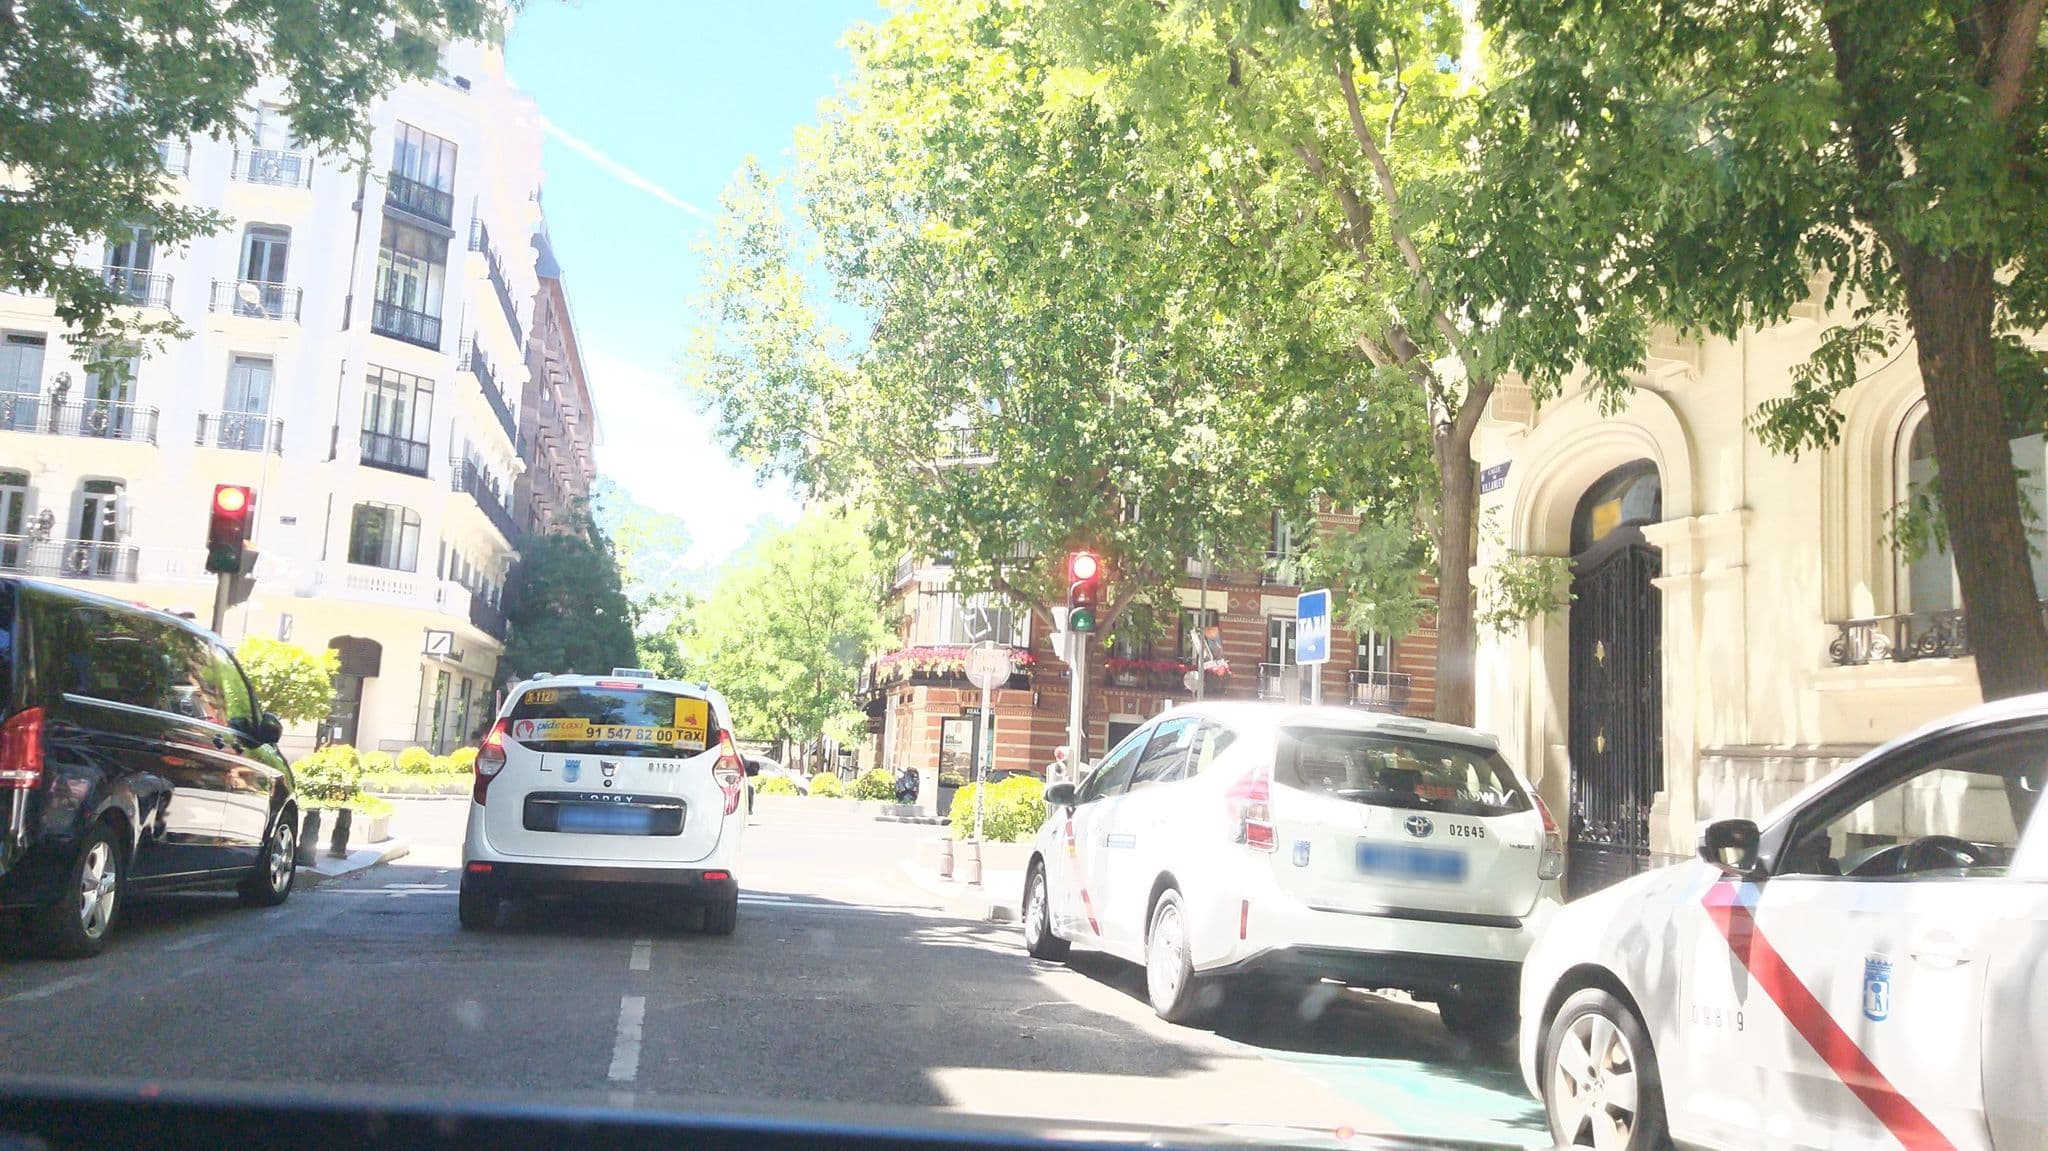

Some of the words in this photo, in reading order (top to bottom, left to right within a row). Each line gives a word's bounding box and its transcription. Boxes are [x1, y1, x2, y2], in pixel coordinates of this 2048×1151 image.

[1298, 614, 1327, 635] TAXI
[586, 727, 601, 738] 91
[607, 727, 632, 739] 547
[636, 729, 653, 740] 82
[656, 730, 673, 742] 00
[676, 729, 705, 742] Taxi
[1457, 788, 1494, 803] NOW
[1449, 823, 1485, 839] 02645
